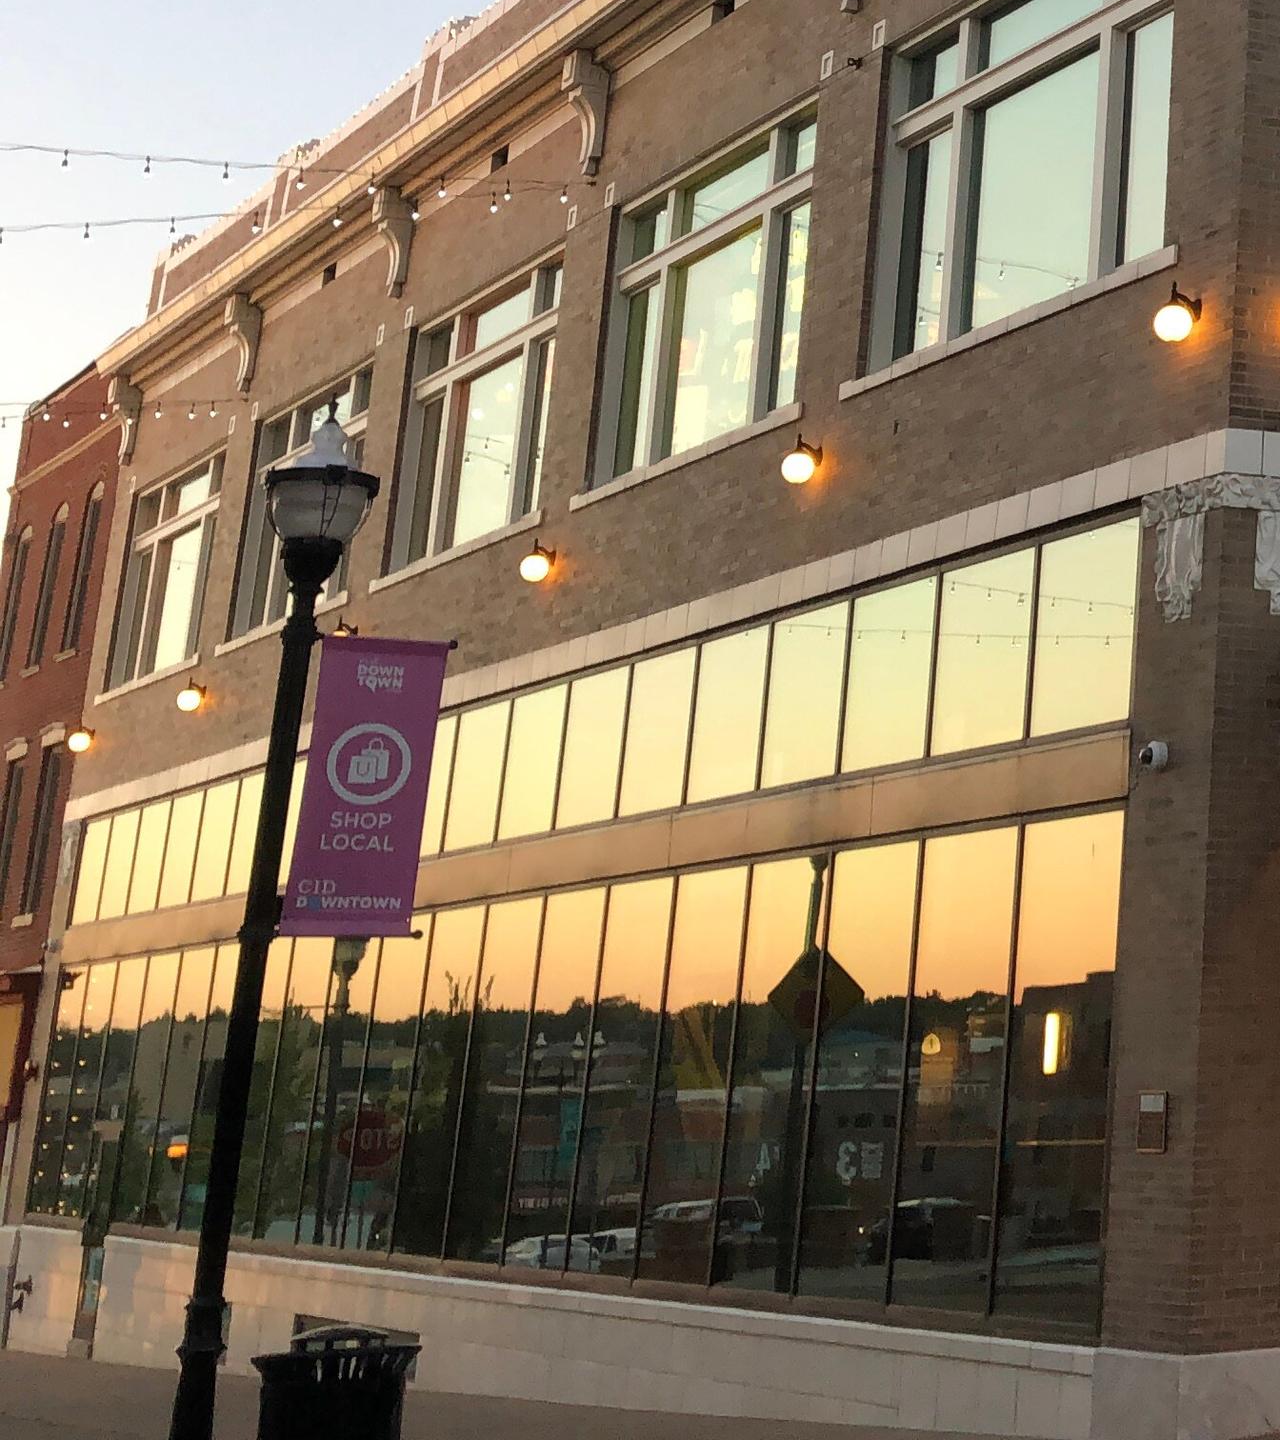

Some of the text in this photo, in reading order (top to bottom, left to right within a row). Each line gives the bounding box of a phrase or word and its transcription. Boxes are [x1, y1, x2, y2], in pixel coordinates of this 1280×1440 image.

[358, 663, 405, 676] DOWN
[357, 675, 404, 692] TOWN
[329, 811, 393, 829] SHOP
[319, 833, 395, 852] LOCAL
[298, 879, 336, 894] CID
